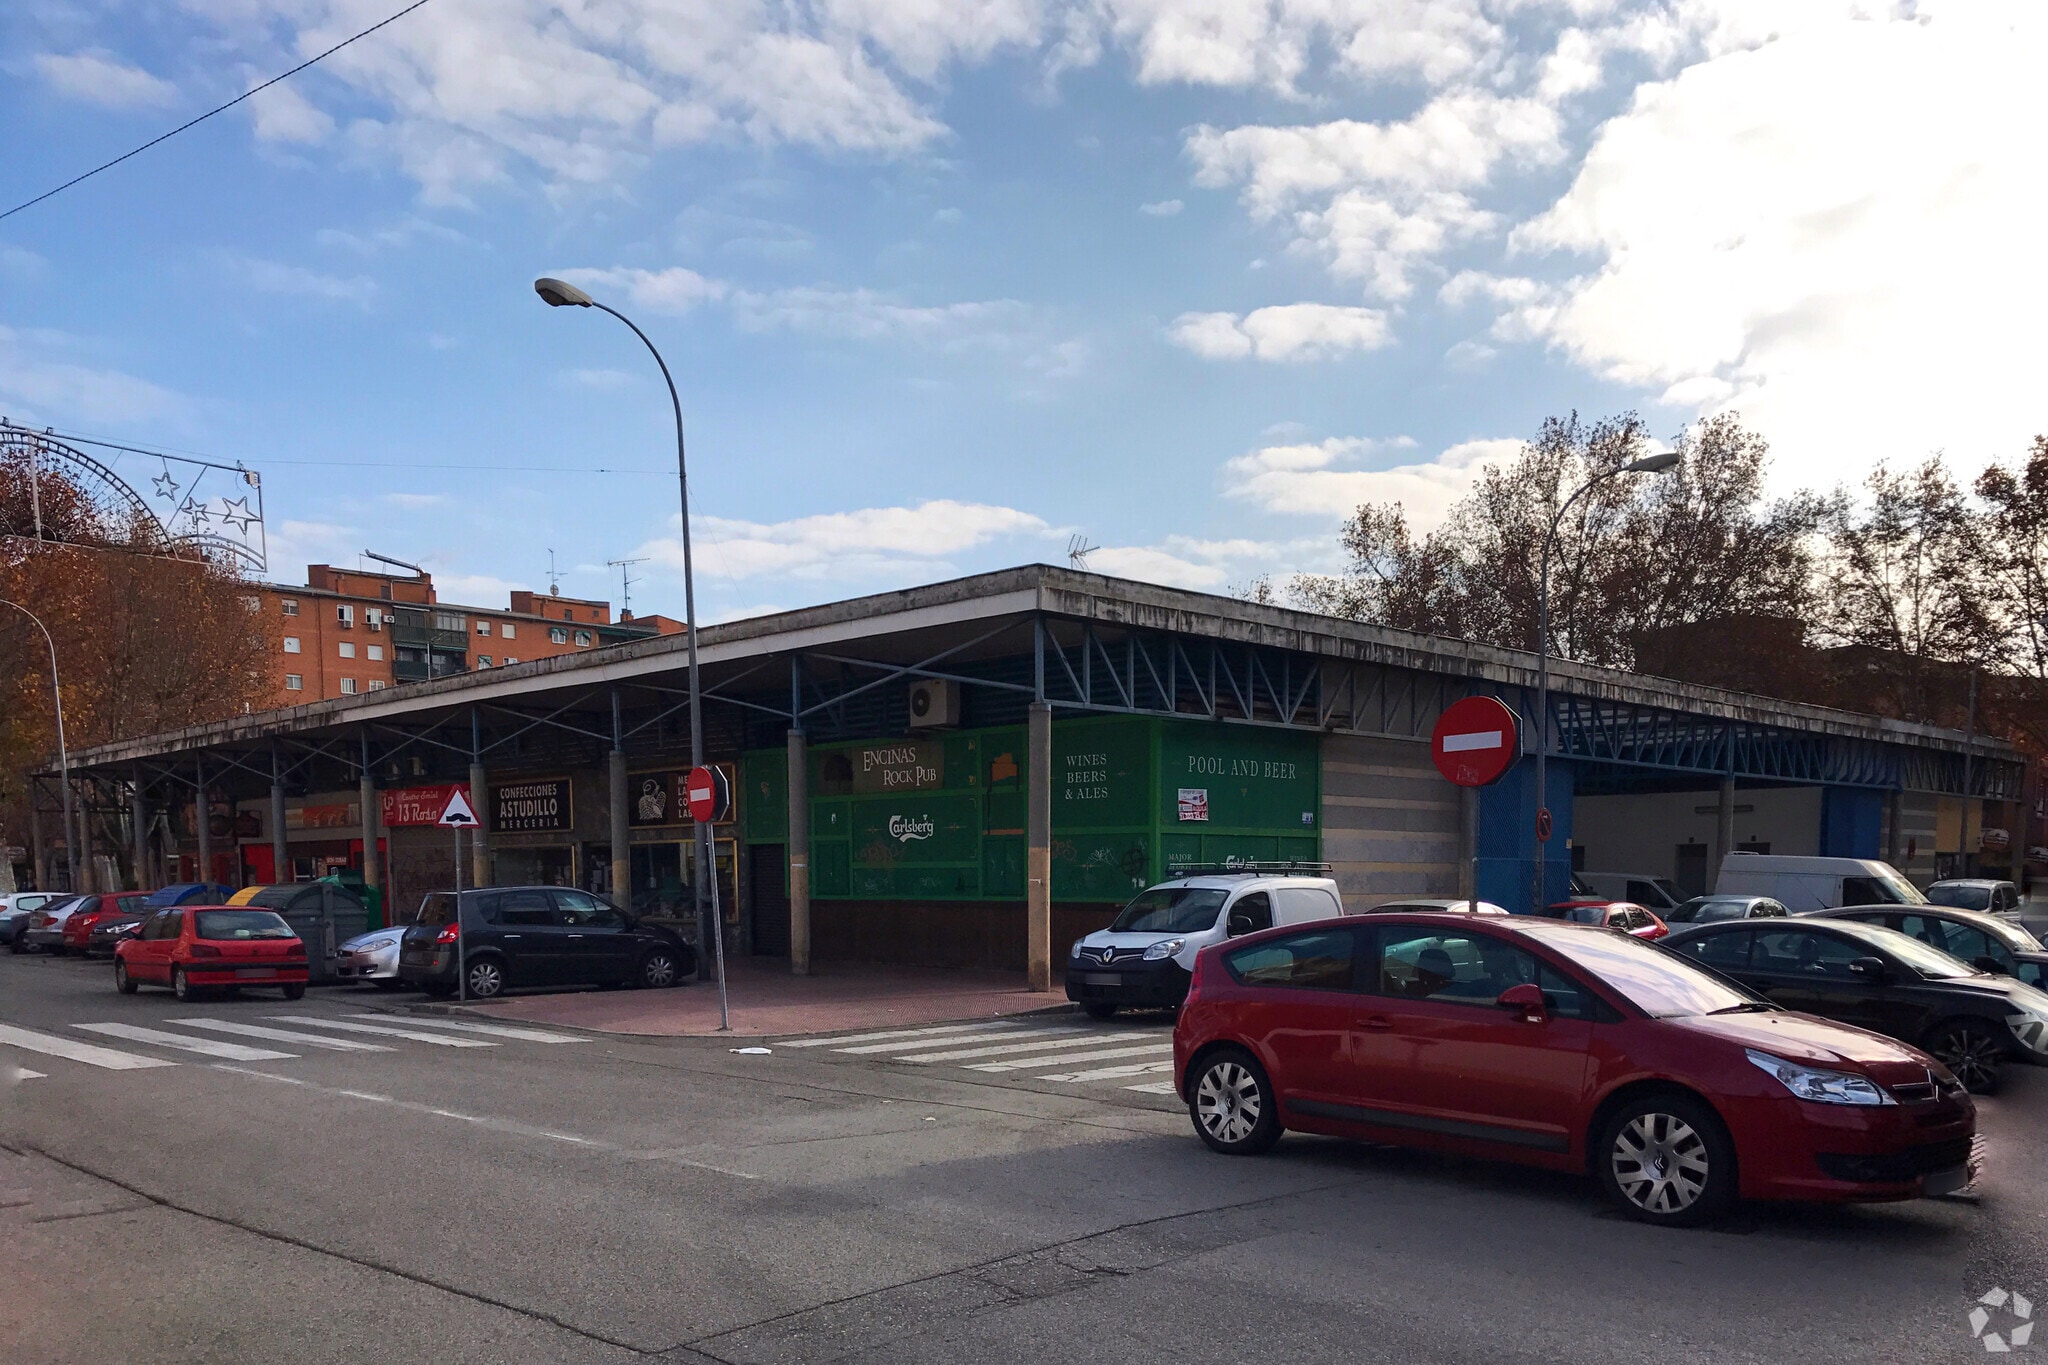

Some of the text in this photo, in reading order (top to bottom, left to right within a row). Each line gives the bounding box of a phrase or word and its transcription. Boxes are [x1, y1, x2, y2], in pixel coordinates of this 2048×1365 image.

[863, 747, 916, 772] ENCINAS
[1066, 753, 1107, 767] WINES
[1188, 755, 1297, 780] POOL AND BEER
[677, 775, 689, 786] ME
[883, 766, 937, 787] ROCK PUB
[1067, 770, 1107, 783] BEERS
[500, 784, 557, 799] CONFECCIONES
[1065, 787, 1109, 800] & ALES
[398, 803, 410, 822] 13
[500, 798, 558, 818] ASTUDILLO
[500, 817, 559, 830] MERCERIA
[889, 814, 934, 843] Carlsberg
